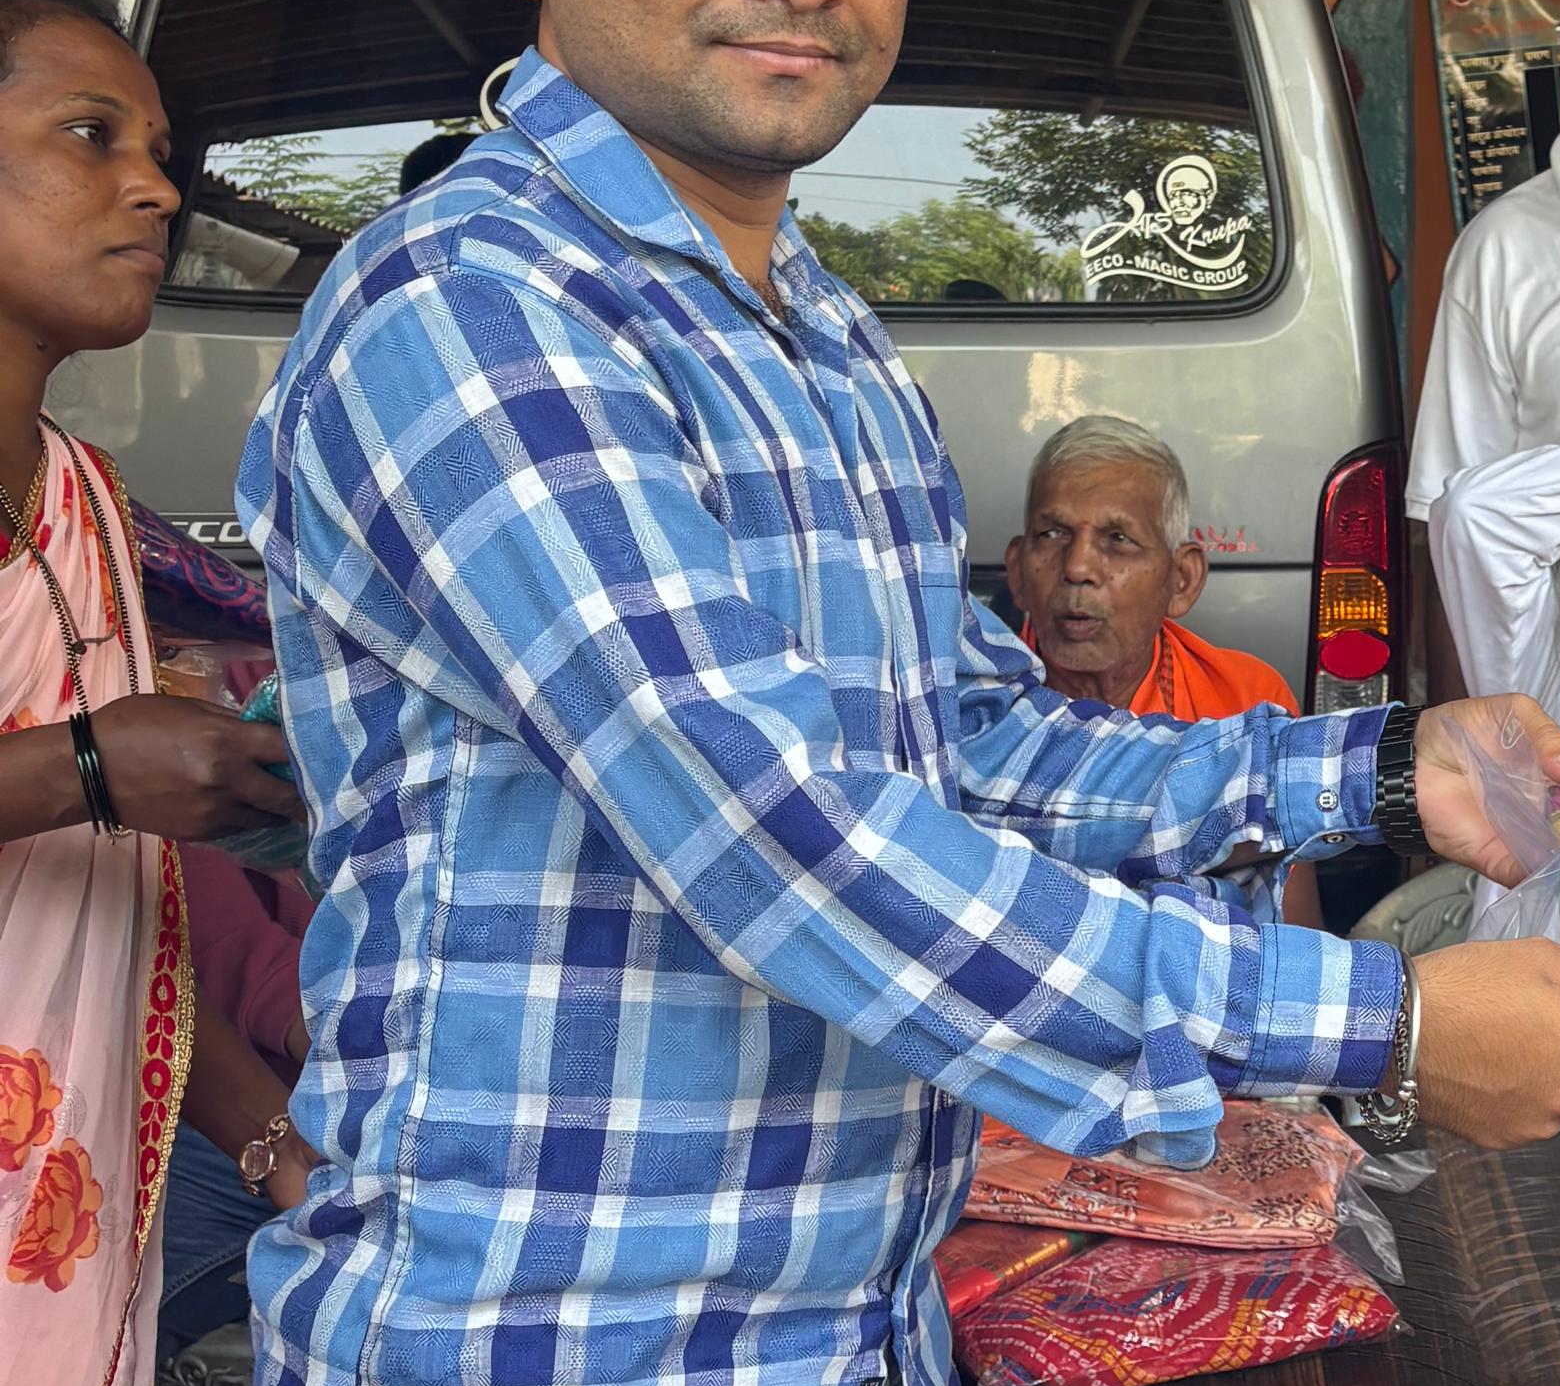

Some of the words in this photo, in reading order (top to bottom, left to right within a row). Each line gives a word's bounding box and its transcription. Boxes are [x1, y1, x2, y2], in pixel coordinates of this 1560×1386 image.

[1179, 215, 1253, 252] Krupa
[1086, 255, 1124, 279] EECO
[1134, 256, 1190, 281] MAGIC
[1193, 260, 1247, 285] GROUP
